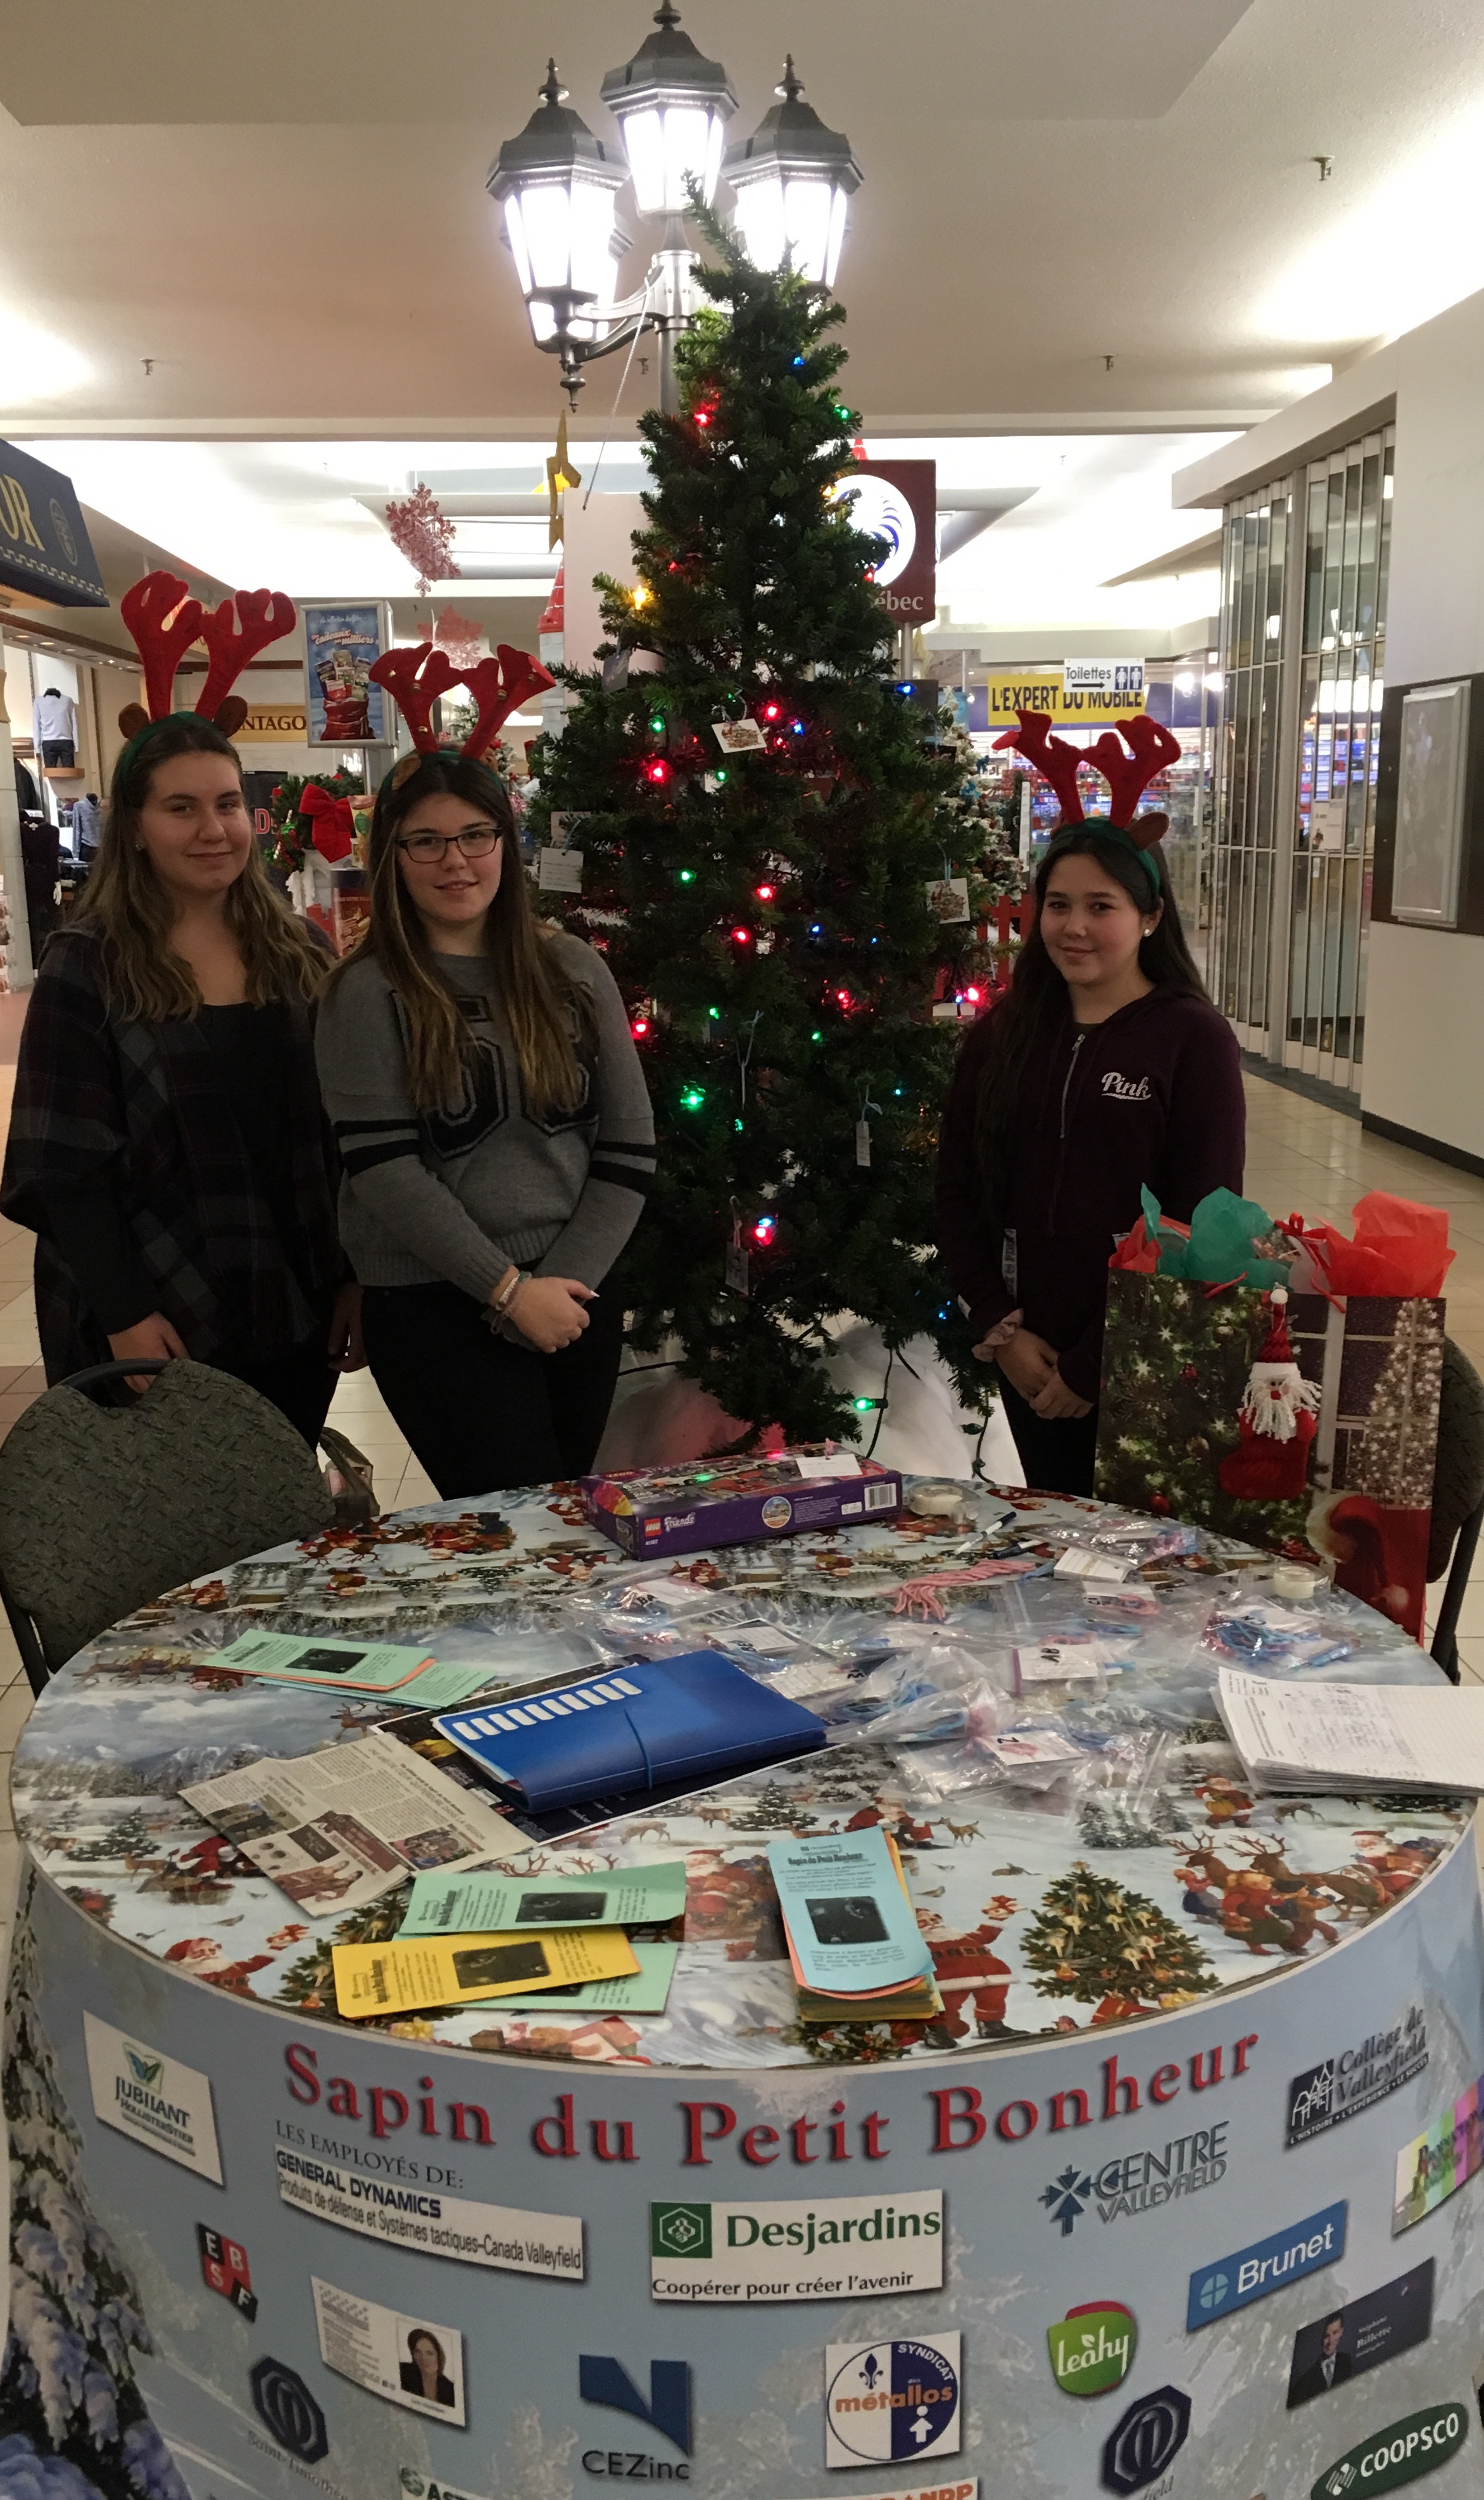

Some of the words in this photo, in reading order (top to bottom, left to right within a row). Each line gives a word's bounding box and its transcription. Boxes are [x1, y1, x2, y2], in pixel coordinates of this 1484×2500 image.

[316, 629, 351, 646] cadeaux
[342, 634, 374, 646] milliers
[1066, 667, 1112, 680] Toilettes
[992, 685, 1059, 712] L'EXPERT
[1064, 691, 1084, 710] DU
[1088, 691, 1143, 708] MOBILE
[1102, 1072, 1152, 1100] Pink
[1337, 2025, 1426, 2102] Valleyfield
[1339, 2026, 1402, 2075] Collège
[1407, 2005, 1424, 2033] de
[115, 2076, 190, 2128] JUBILANT
[284, 2042, 496, 2145] Sapin
[533, 2094, 640, 2161] du
[680, 2100, 891, 2166] Petit
[929, 2033, 1260, 2152] Bonheur
[275, 2119, 305, 2145] LES
[311, 2133, 419, 2180] EMPLOYÉS
[426, 2165, 465, 2190] DE:
[1096, 2120, 1229, 2199] CENTRE
[277, 2150, 346, 2193] GENERAL
[350, 2177, 441, 2219] DYNAMICS
[1097, 2159, 1228, 2224] VALLEYFIELD
[279, 2171, 313, 2204] Produits
[315, 2190, 327, 2209] de
[328, 2193, 365, 2223] défense
[365, 2212, 376, 2229] et
[379, 2209, 428, 2243] Systèmes
[525, 2241, 582, 2270] Valleyfield
[726, 2208, 941, 2256] Desjardins
[206, 2232, 220, 2260] E
[229, 2246, 243, 2271] B
[1238, 2223, 1335, 2295] Brunet
[210, 2263, 223, 2289] S
[237, 2287, 253, 2306] F
[652, 2277, 741, 2299] Coopérer
[746, 2282, 791, 2299] pour
[795, 2275, 843, 2294] créer
[848, 2270, 914, 2292] l'avenir
[898, 2344, 955, 2382] SYNDICAT
[835, 2386, 953, 2414] métallos
[581, 2449, 691, 2480] CEZinc
[1361, 2413, 1459, 2478] COOPSCO
